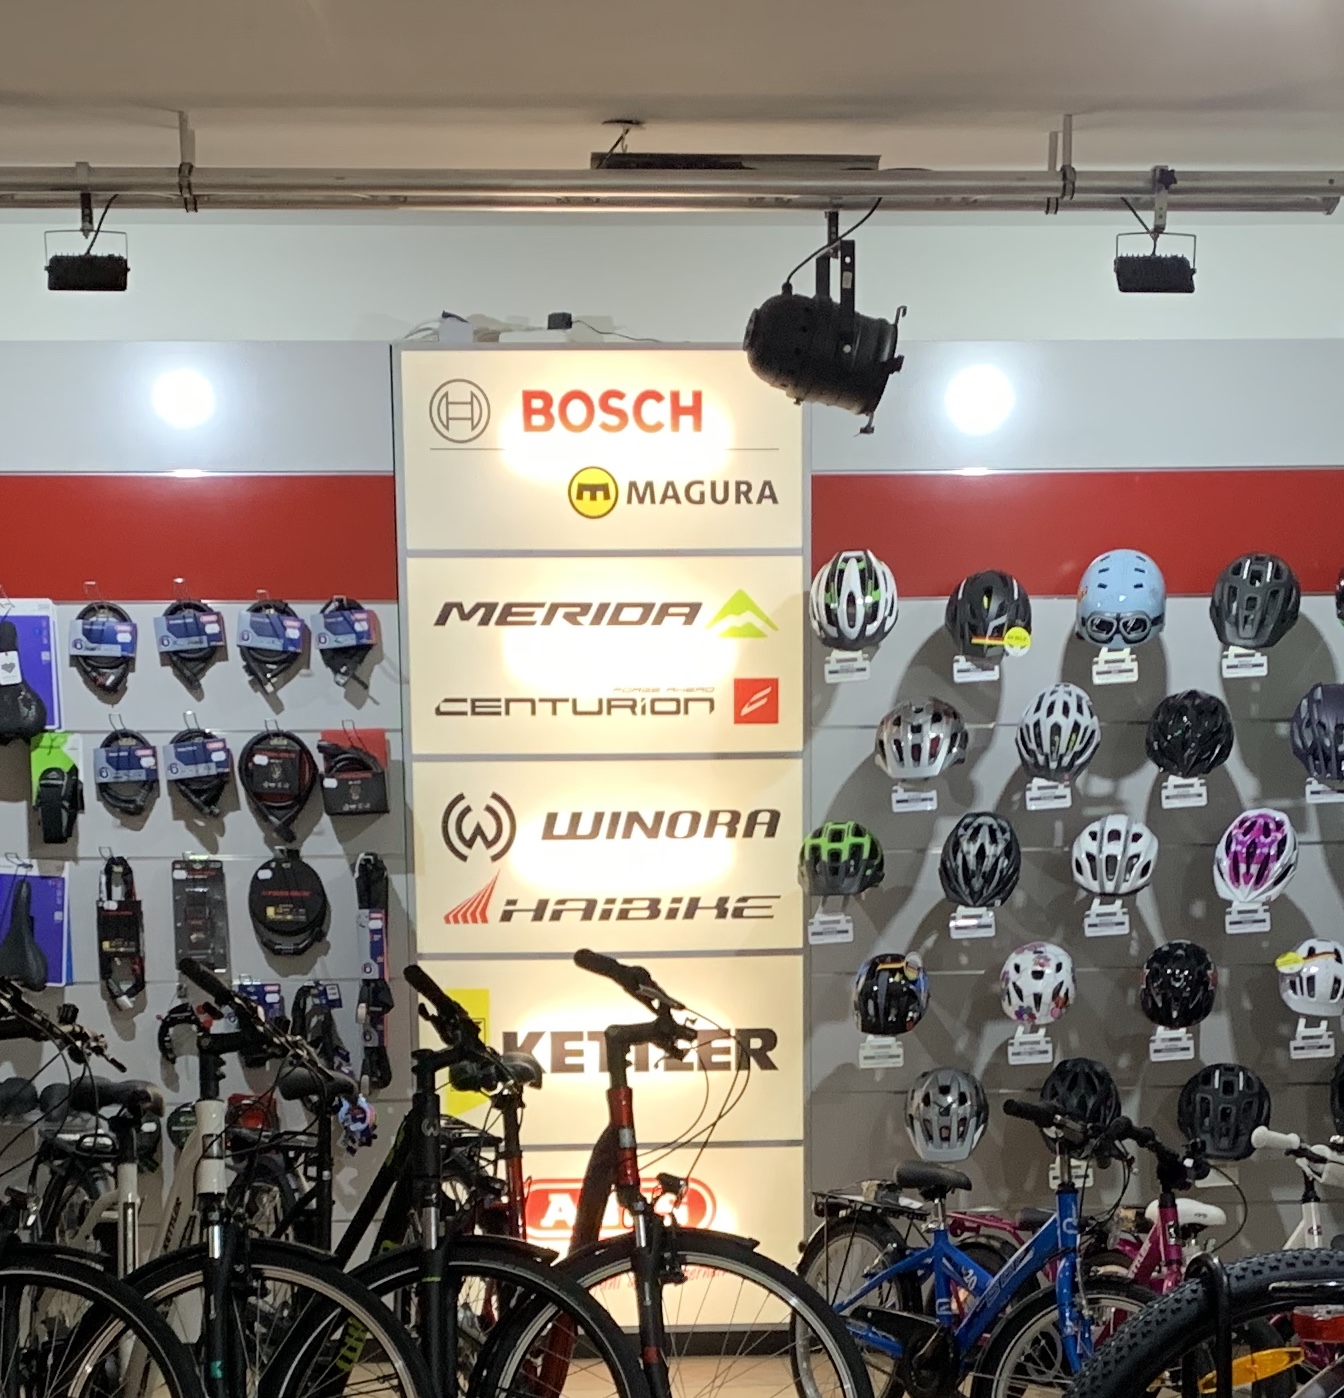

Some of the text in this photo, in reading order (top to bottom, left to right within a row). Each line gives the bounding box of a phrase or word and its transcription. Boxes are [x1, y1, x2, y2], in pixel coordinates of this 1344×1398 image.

[522, 390, 703, 434] BOSCH
[626, 479, 779, 505] MAGURA
[433, 601, 704, 627] MERIDA
[435, 697, 715, 716] CENTURION
[541, 810, 781, 841] WINORA
[499, 895, 781, 923] HAIBIKE
[540, 1192, 689, 1228] AS
